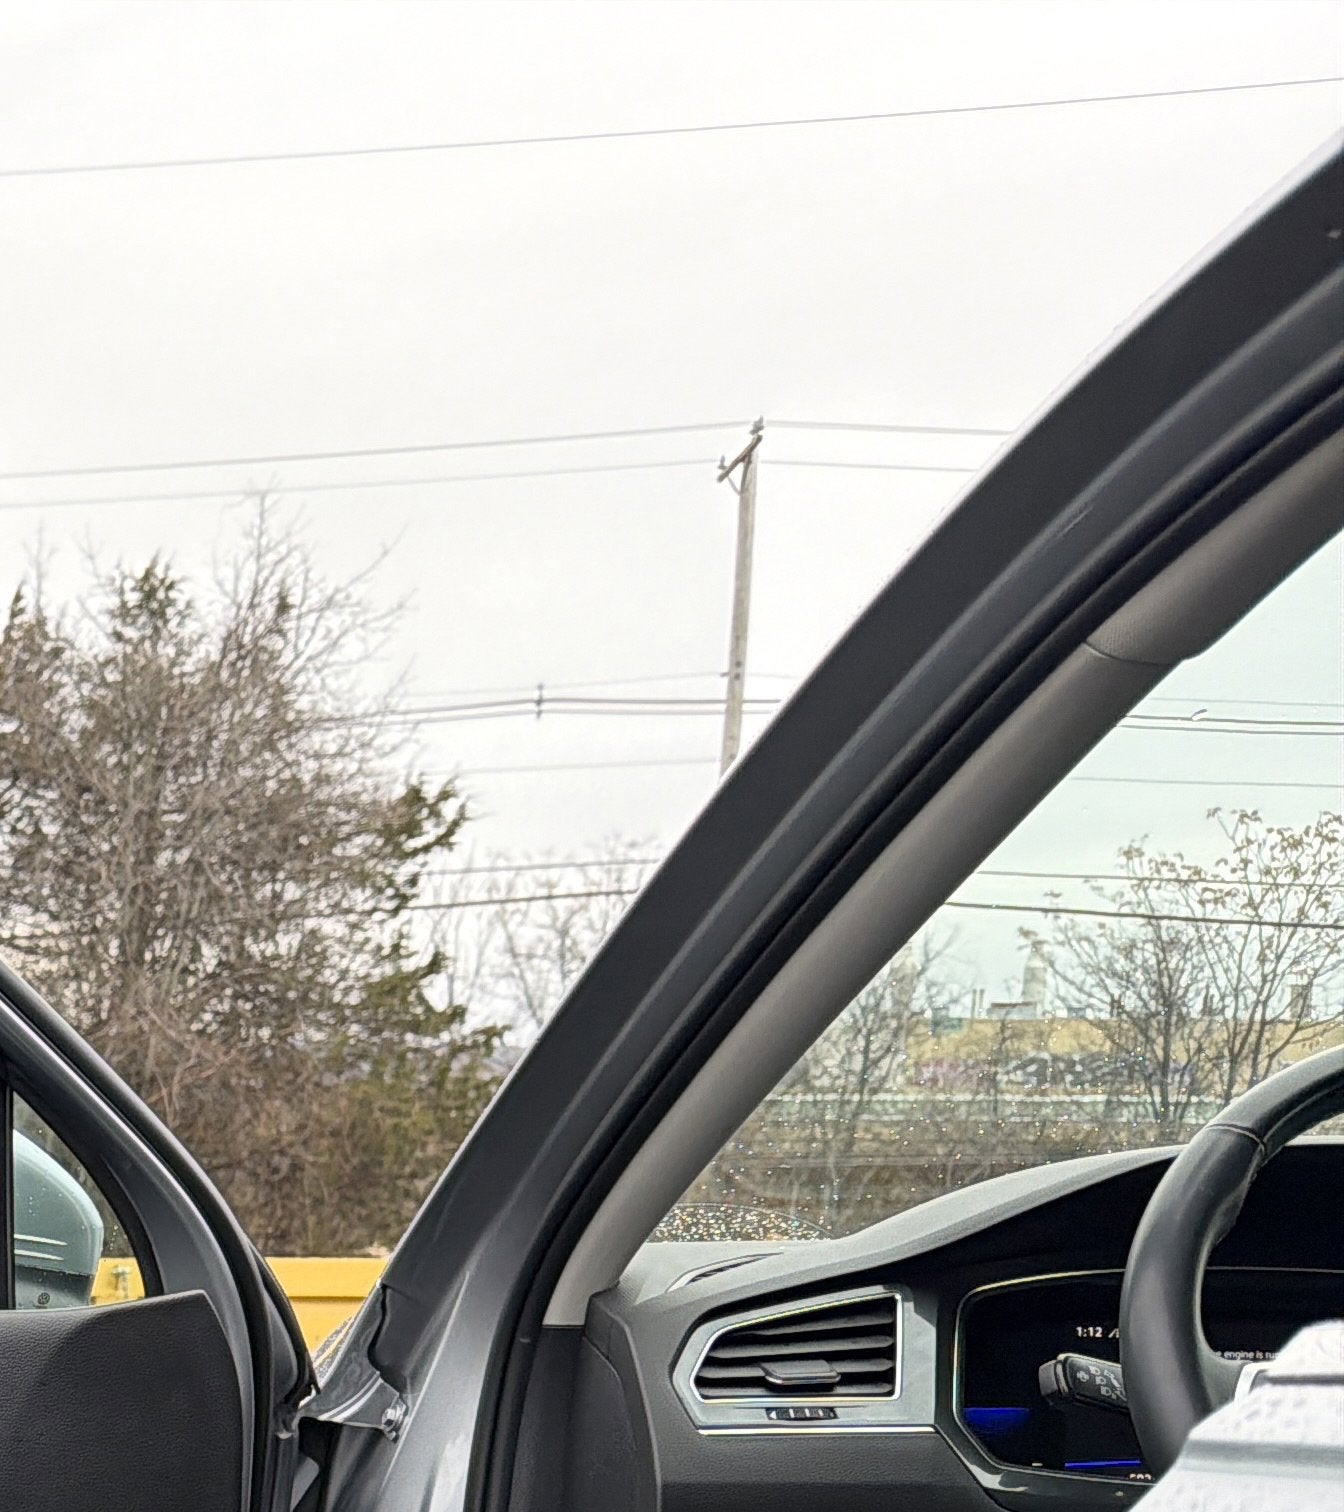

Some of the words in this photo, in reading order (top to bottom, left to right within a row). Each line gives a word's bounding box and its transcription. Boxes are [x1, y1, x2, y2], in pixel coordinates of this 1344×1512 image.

[1076, 1326, 1102, 1338] 1:12
[1224, 1349, 1254, 1360] engine
[1256, 1350, 1264, 1359] is
